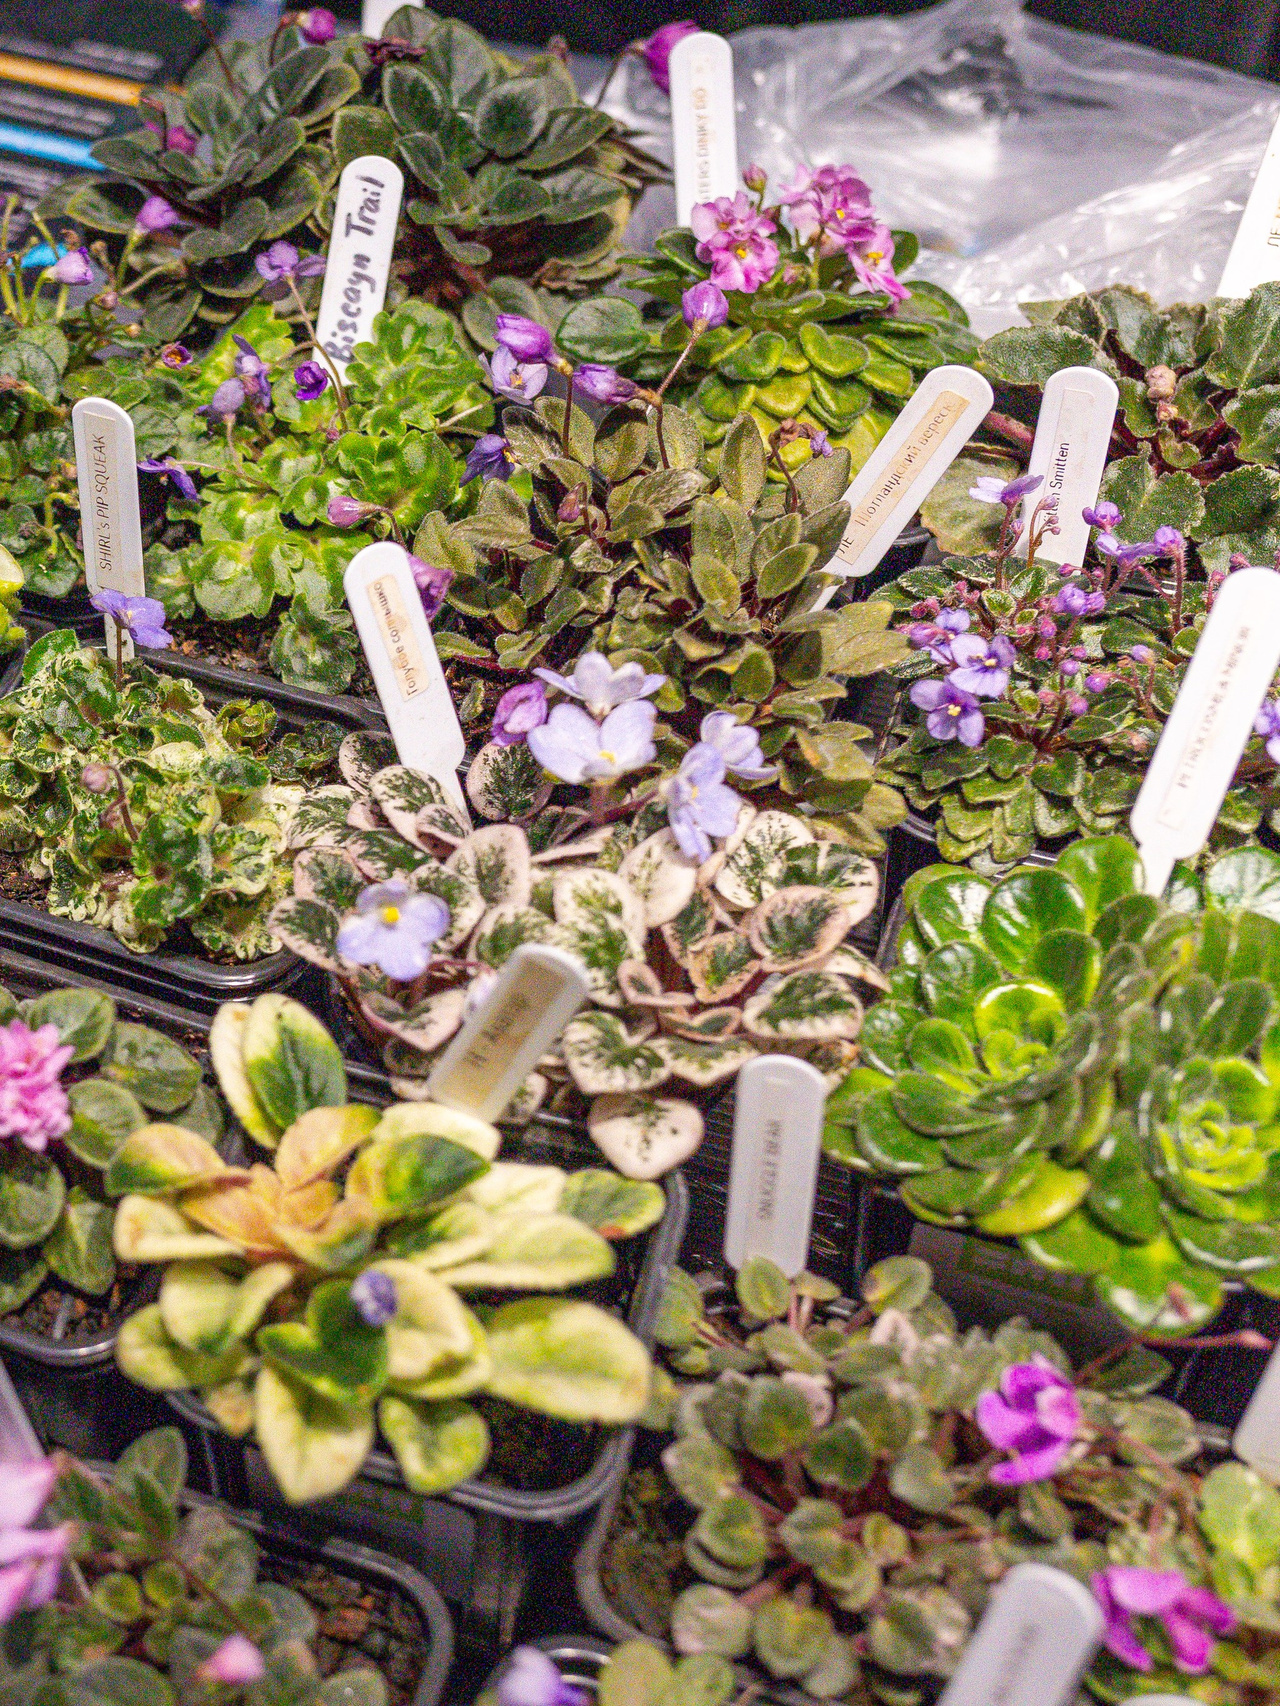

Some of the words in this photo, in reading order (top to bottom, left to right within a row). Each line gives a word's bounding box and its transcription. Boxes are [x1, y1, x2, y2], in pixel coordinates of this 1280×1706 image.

[341, 172, 387, 244] Trail
[322, 252, 378, 364] Biscayn
[92, 432, 110, 494] SQUEAK
[1051, 440, 1070, 490] Smitten
[95, 494, 109, 519] PIP
[97, 521, 112, 571] SHIRL's
